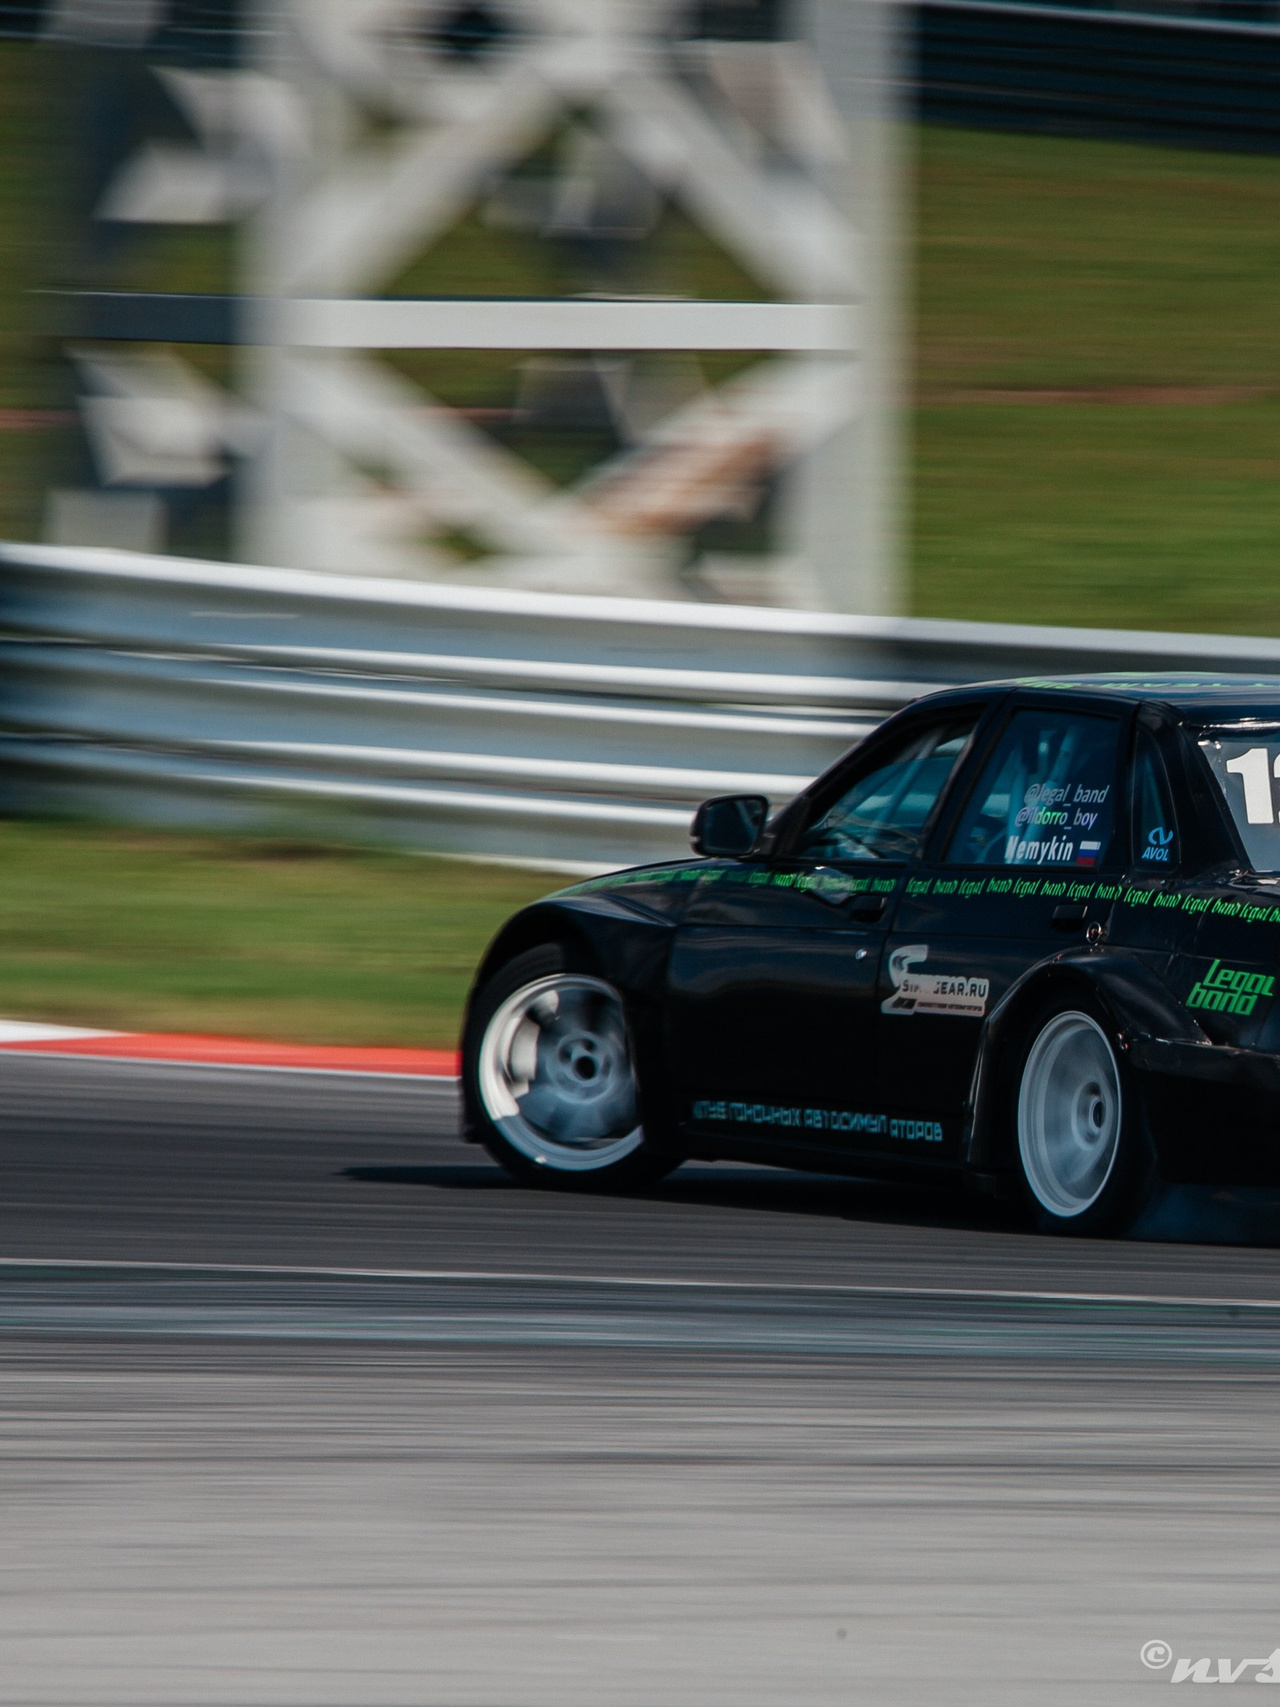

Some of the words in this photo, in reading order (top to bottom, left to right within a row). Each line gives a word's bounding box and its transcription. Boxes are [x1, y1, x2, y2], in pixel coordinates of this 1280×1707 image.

[1024, 783, 1110, 807] @legal_band
[1004, 835, 1075, 866] Nemykin
[1142, 846, 1170, 861] AVOL
